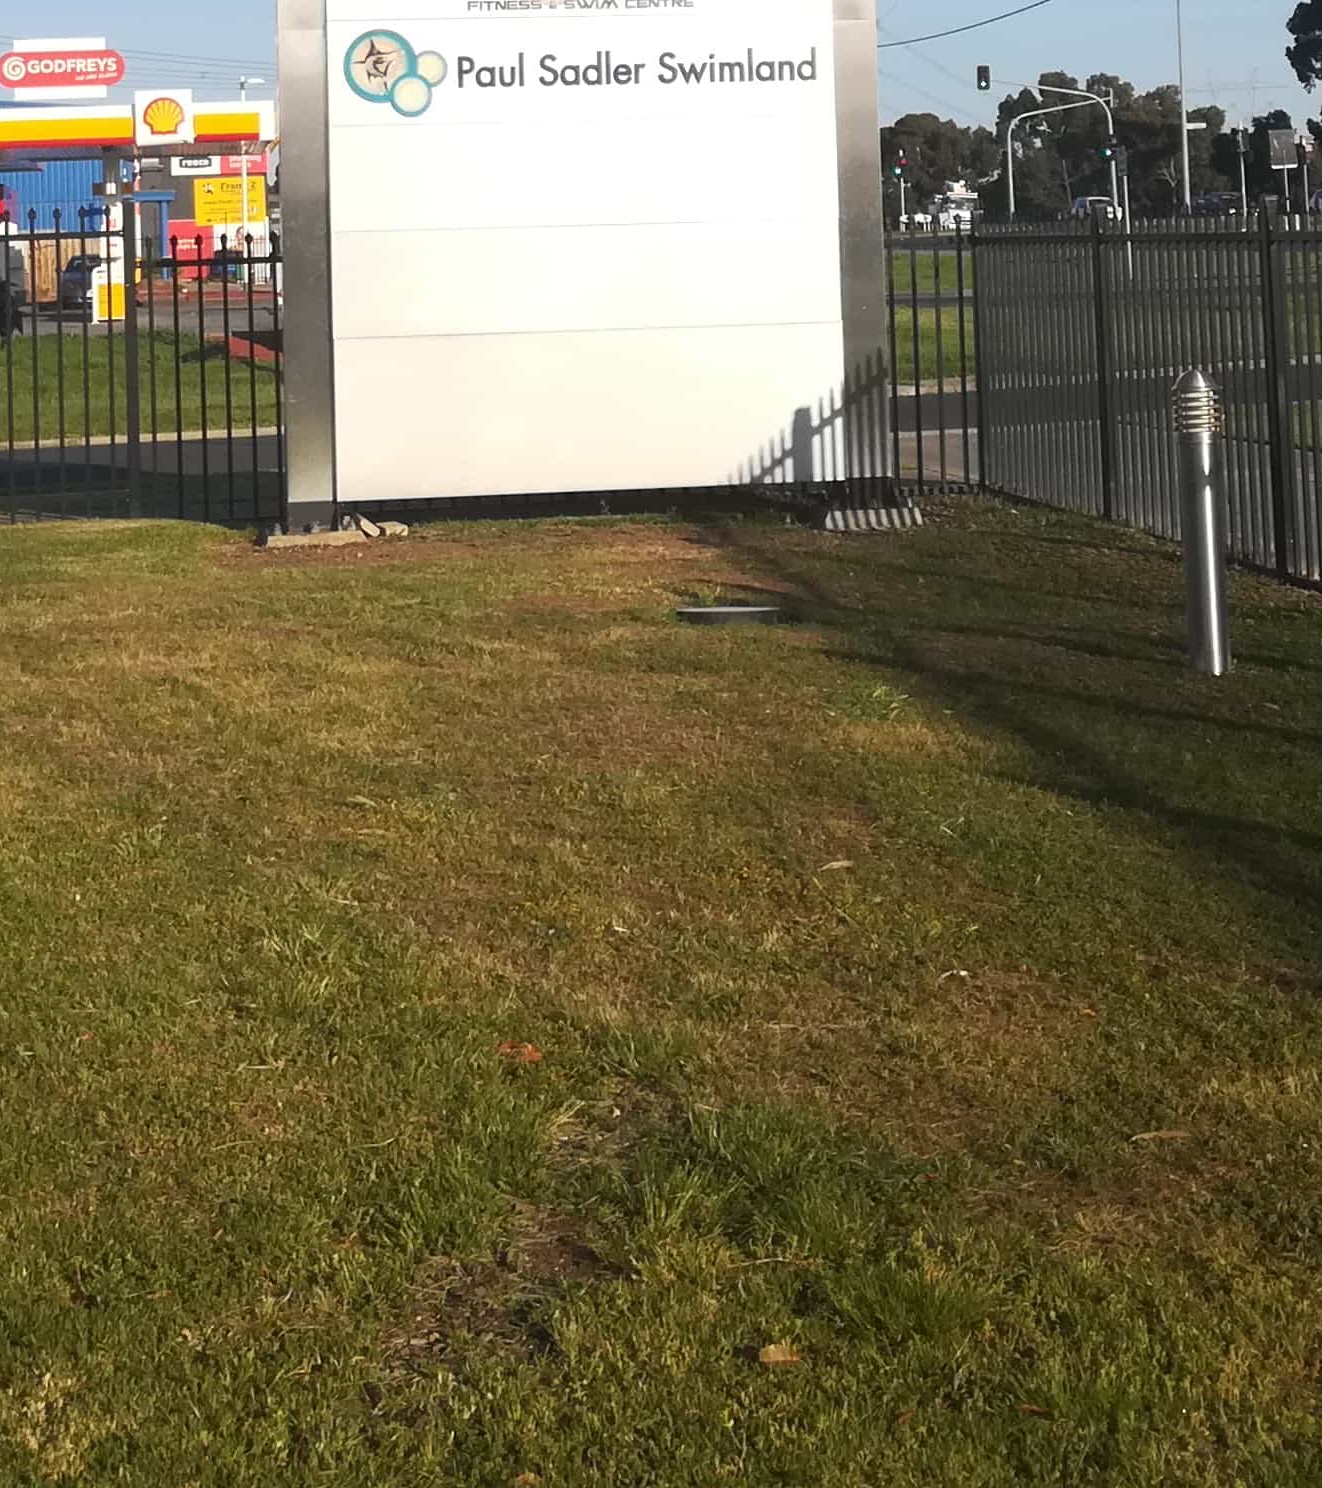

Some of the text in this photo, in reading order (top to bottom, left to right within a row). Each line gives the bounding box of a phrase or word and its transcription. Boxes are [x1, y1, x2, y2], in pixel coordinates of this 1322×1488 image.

[466, 0, 542, 12] FITNESS
[27, 57, 118, 74] GODFREYS
[456, 46, 817, 89] Paul Sadler Swimland
